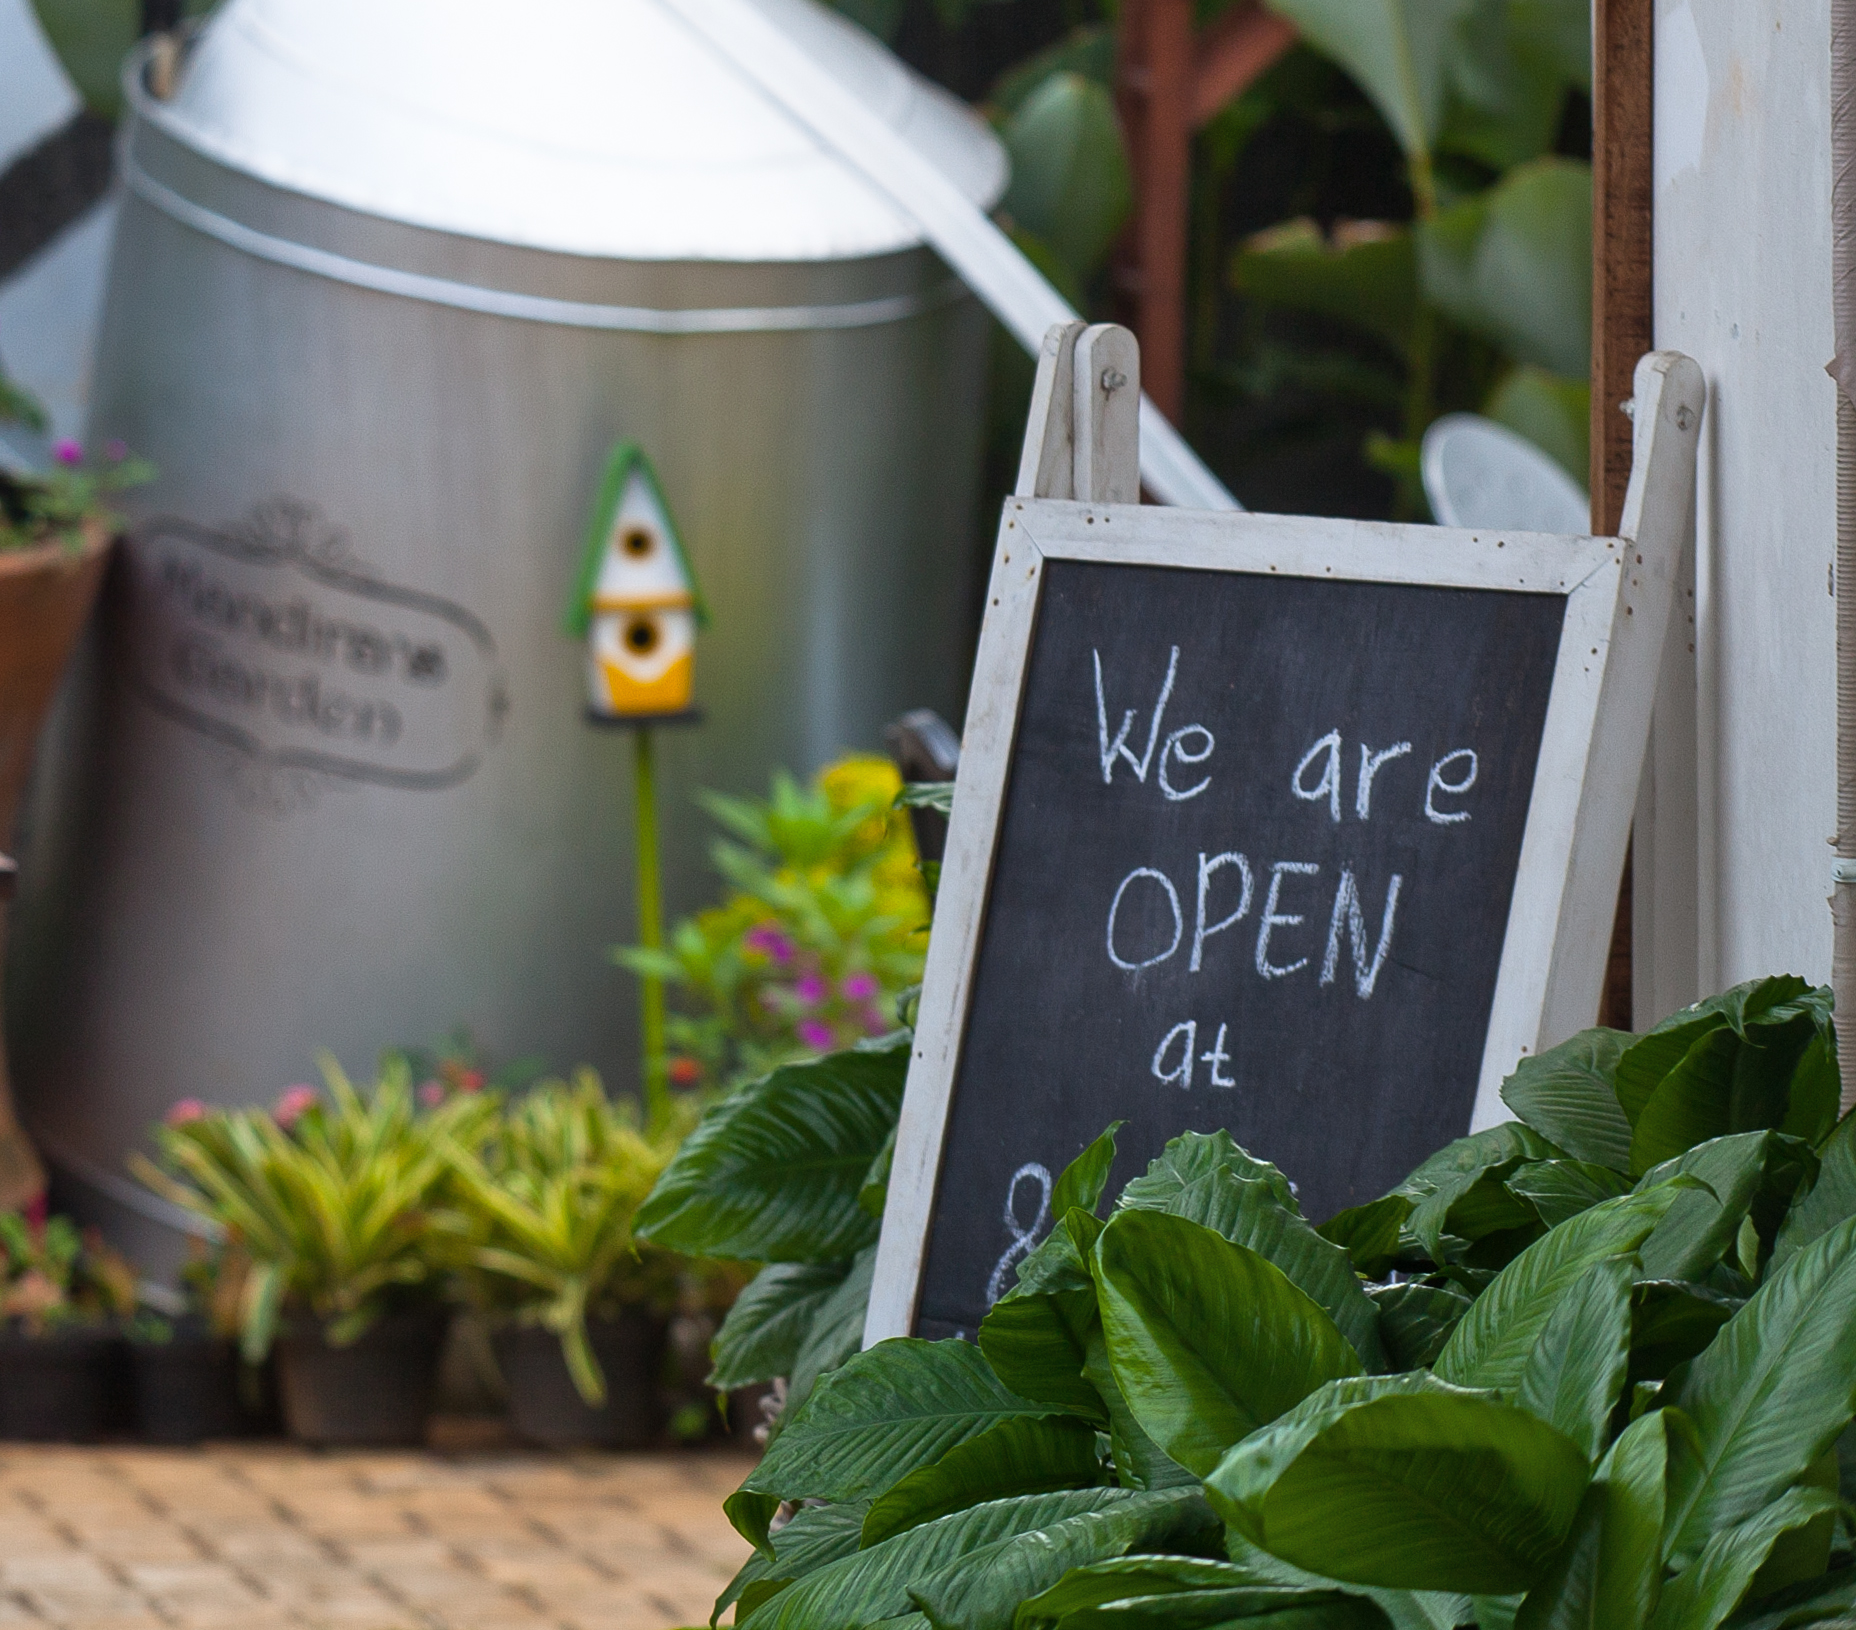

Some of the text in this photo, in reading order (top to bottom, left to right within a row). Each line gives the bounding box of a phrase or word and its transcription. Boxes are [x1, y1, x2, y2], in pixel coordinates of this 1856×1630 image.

[1092, 644, 1479, 825] We are
[1105, 850, 1403, 1000] OPEN
[1150, 1018, 1236, 1089] at
